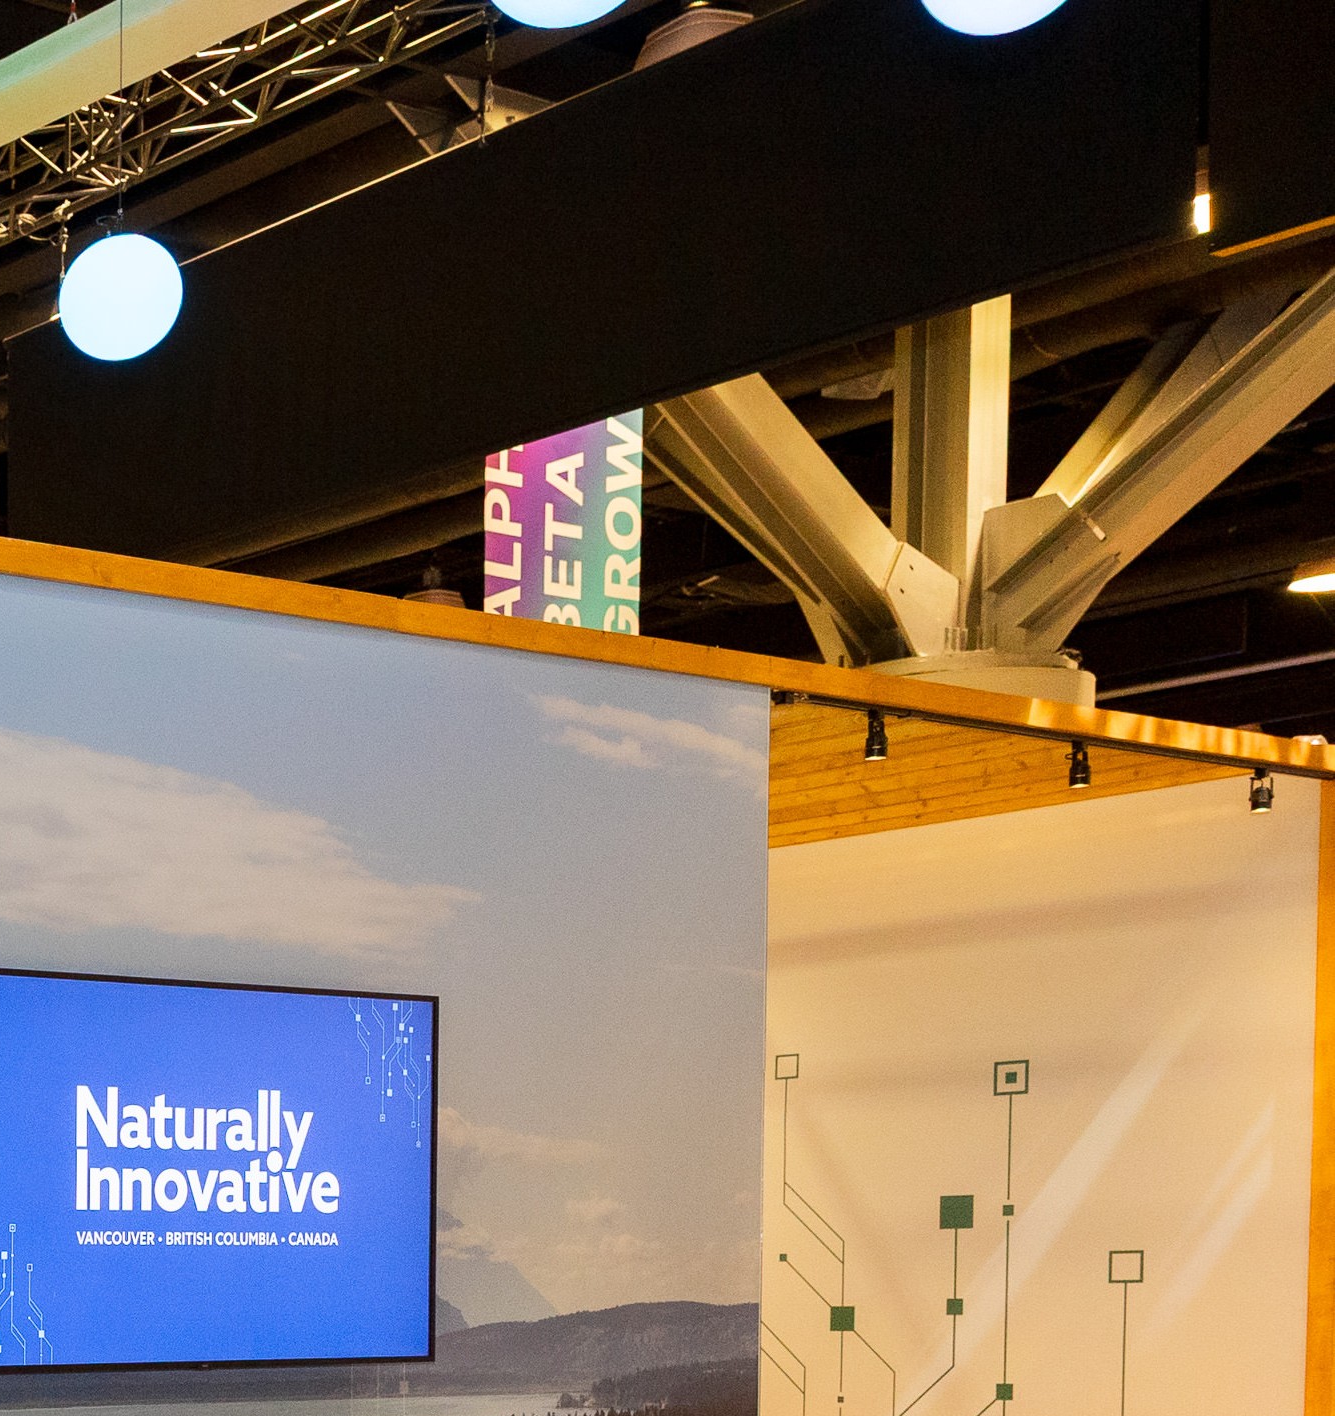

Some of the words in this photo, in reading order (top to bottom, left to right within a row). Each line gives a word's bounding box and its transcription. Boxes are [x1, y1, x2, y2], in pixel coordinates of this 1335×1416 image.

[75, 1085, 314, 1170] Naturally
[75, 1149, 340, 1214] Innovative
[76, 1230, 155, 1246] VANCOUVER
[165, 1230, 213, 1246] BRITISH
[215, 1230, 279, 1246] COLUMBIA
[288, 1230, 339, 1246] CANADA
